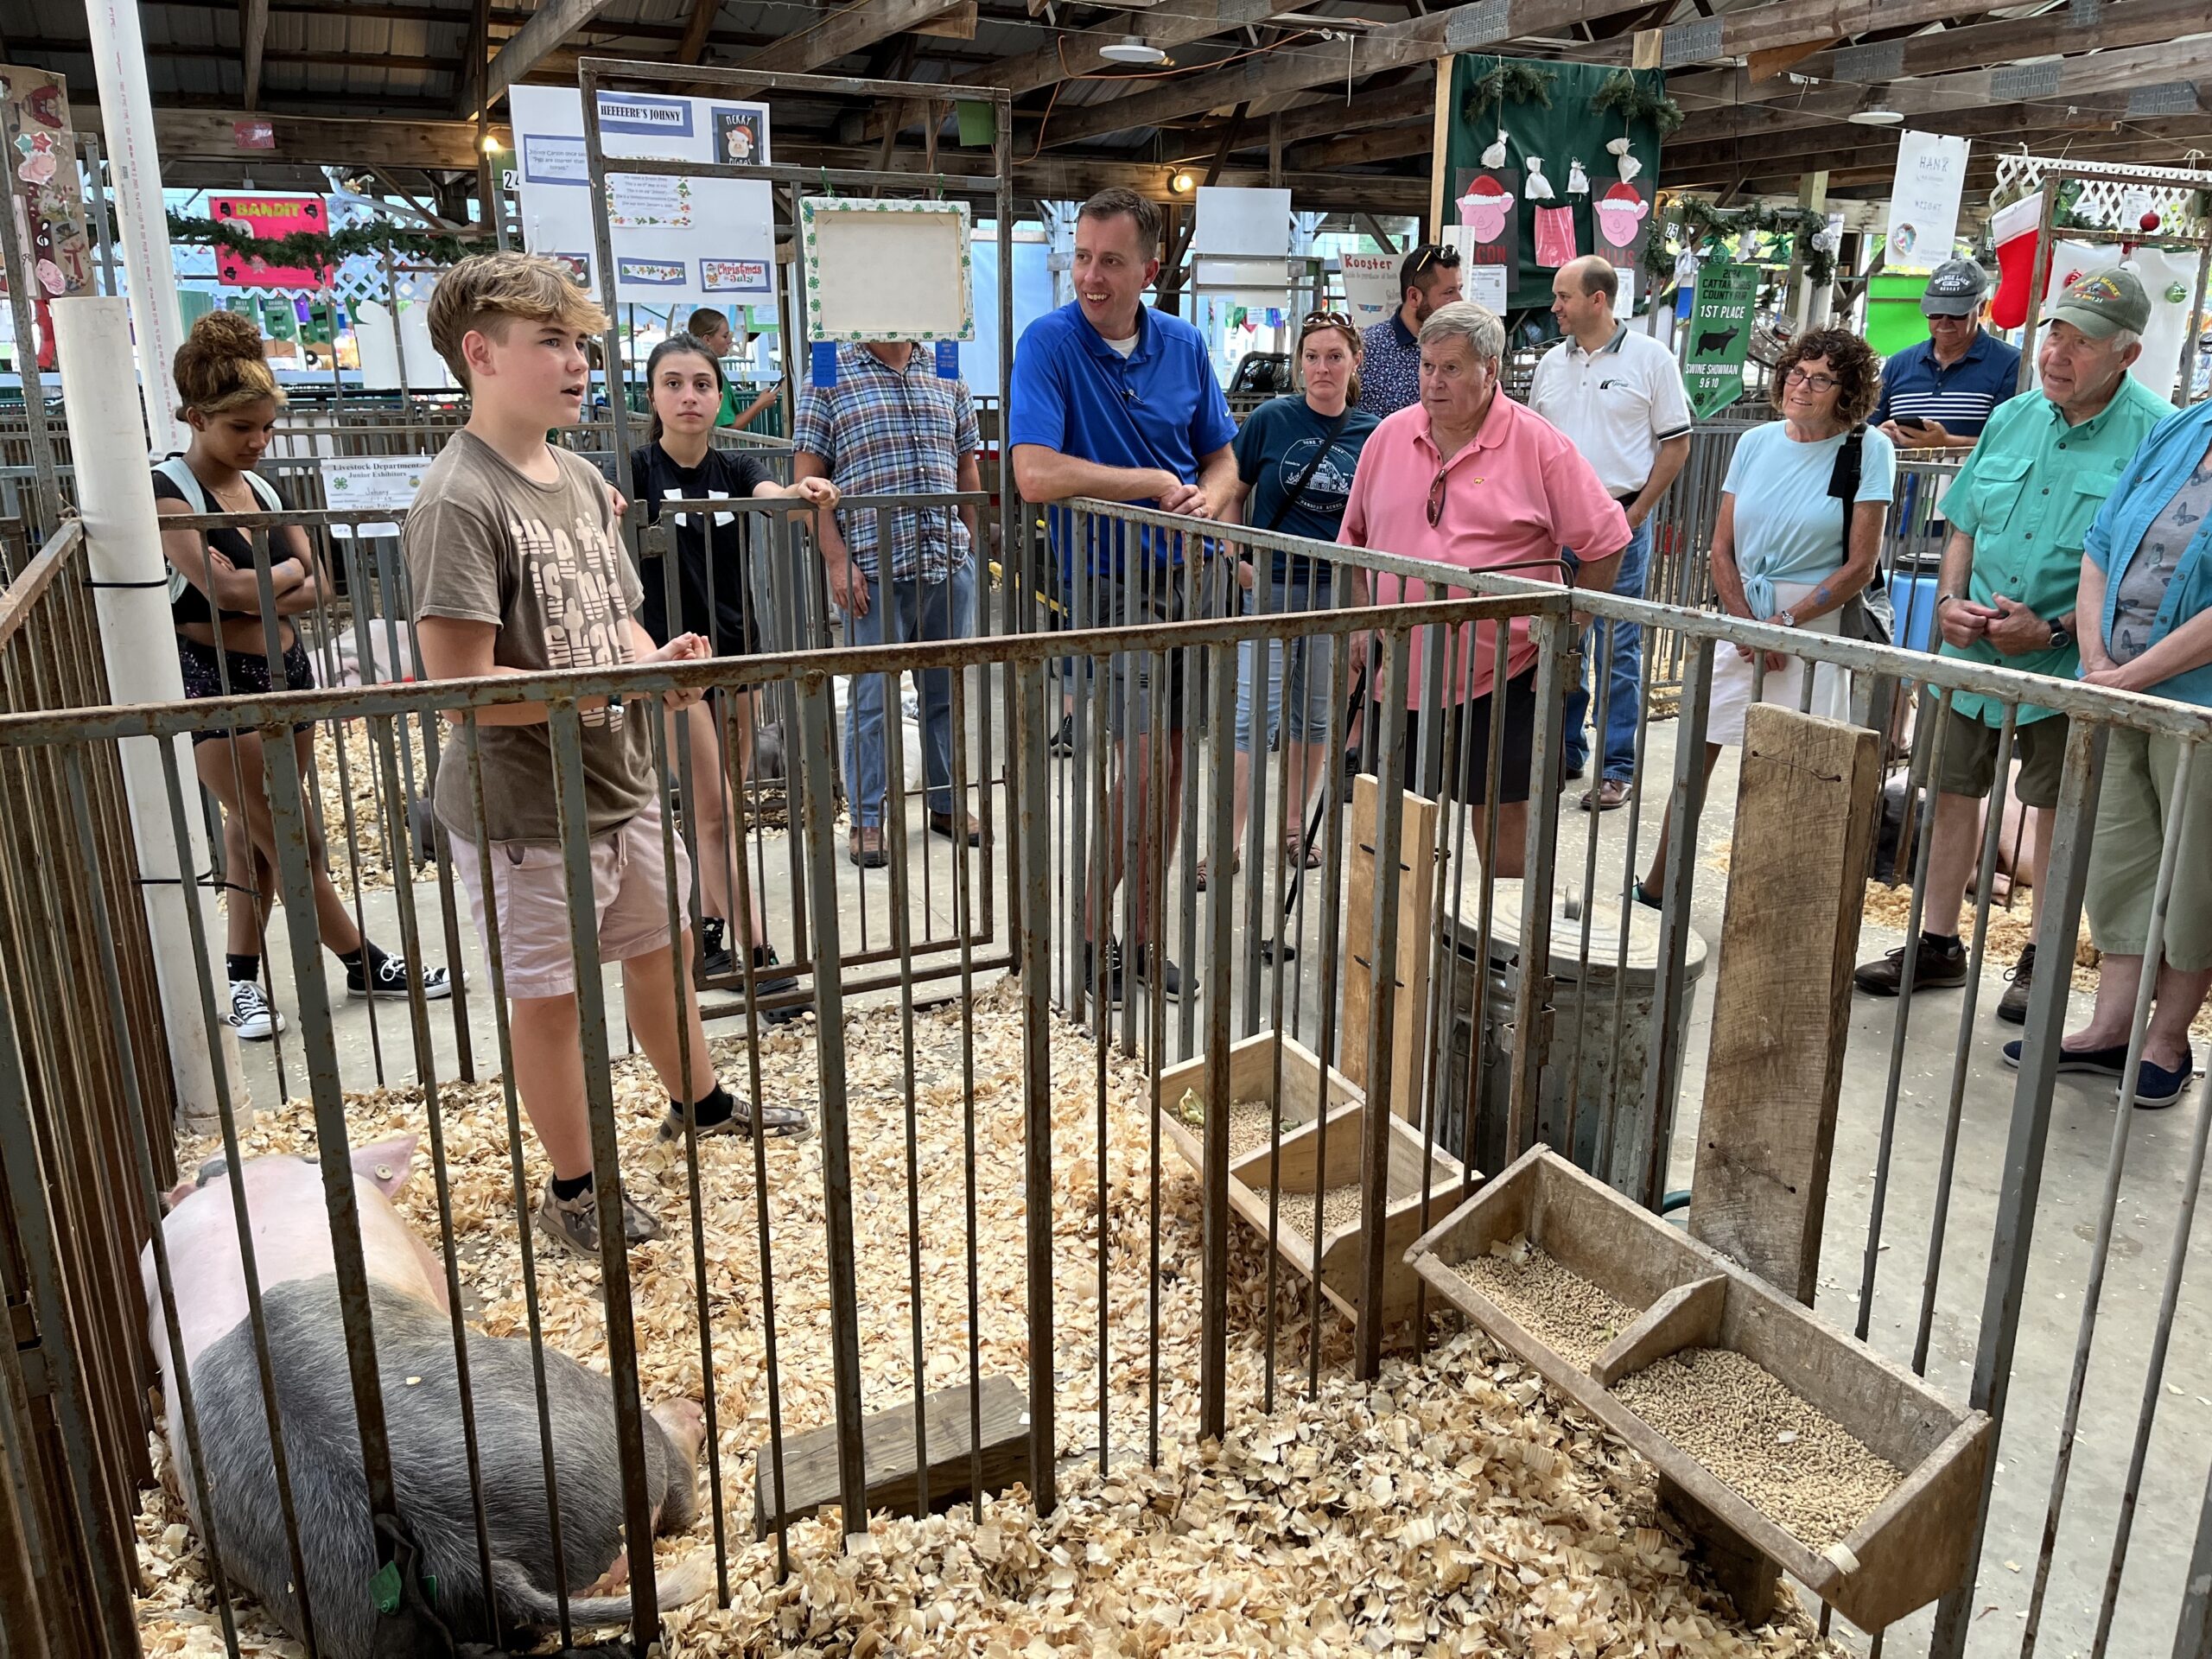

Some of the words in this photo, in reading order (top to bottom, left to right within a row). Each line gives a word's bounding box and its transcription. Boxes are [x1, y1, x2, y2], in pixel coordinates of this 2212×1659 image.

[649, 109, 681, 122] JOHNNY
[726, 114, 753, 125] MERRY
[235, 202, 302, 218] BANDIT
[1666, 224, 1679, 238] 25
[1344, 254, 1393, 270] Rooster
[717, 263, 762, 276] Christmas
[1702, 289, 1732, 301] COUNTY
[1700, 305, 1719, 319] 1ST
[1719, 306, 1745, 319] PLACE
[1685, 363, 1707, 375] SWINE
[1707, 364, 1738, 375] SHOWMAN
[1699, 377, 1705, 389] 9
[1704, 378, 1711, 389] &
[1711, 378, 1719, 389] 10
[333, 463, 372, 472] Livestock
[372, 461, 420, 471] Department
